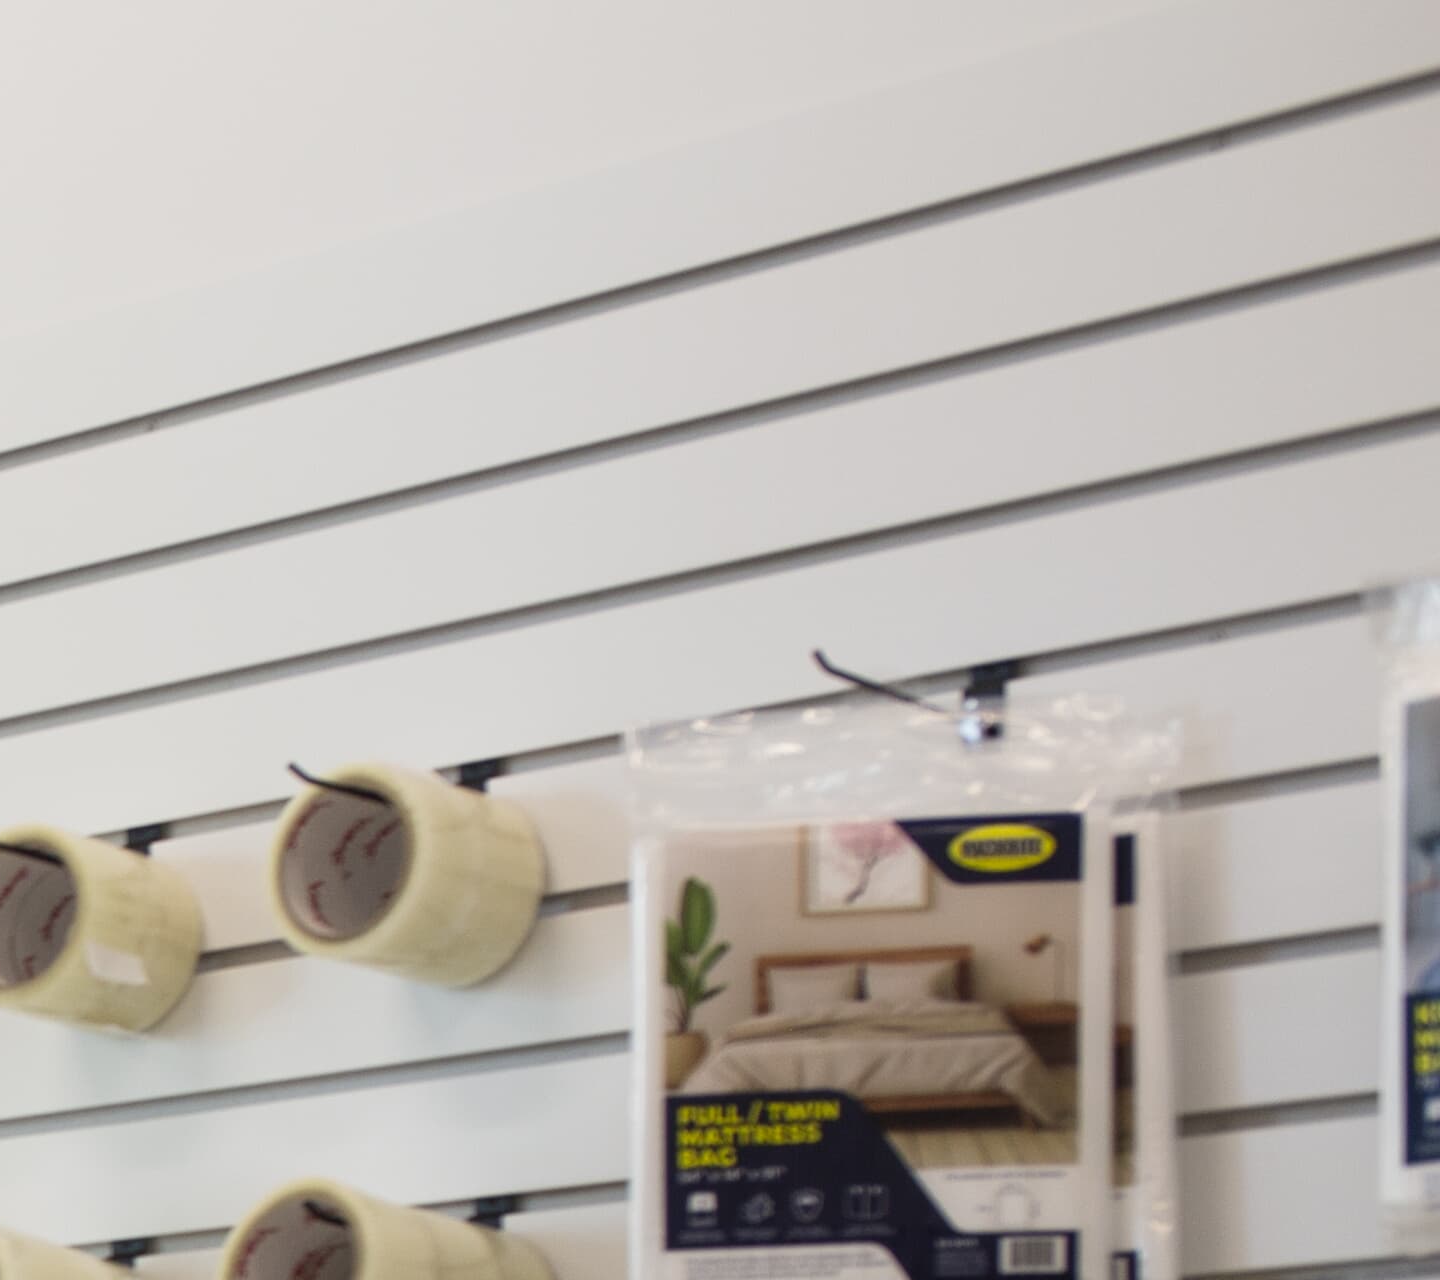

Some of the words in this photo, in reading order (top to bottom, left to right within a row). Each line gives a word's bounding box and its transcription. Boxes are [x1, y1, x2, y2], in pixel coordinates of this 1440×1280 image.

[676, 1104, 741, 1126] FULL
[768, 1100, 840, 1121] TWIN
[676, 1122, 822, 1148] MATTRESS
[676, 1147, 736, 1169] BAG
